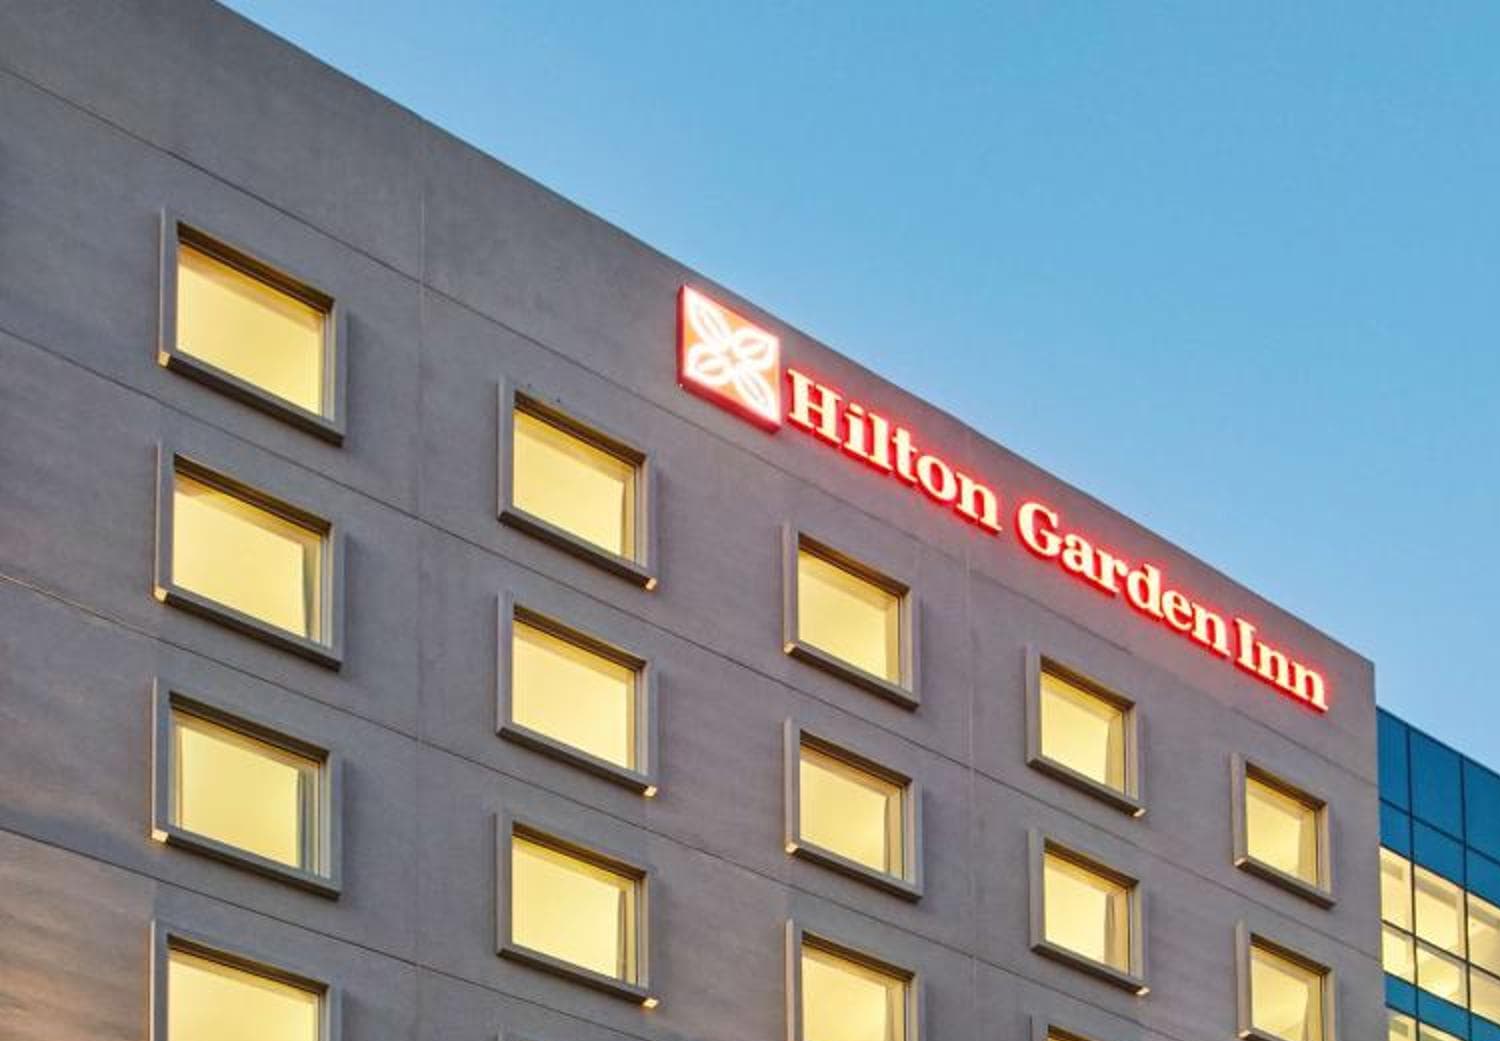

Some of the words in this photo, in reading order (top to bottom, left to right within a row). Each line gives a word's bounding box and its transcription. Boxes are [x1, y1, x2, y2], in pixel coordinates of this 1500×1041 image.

[786, 367, 1002, 533] Hilton
[1016, 499, 1231, 658] Garden
[1232, 616, 1329, 712] Inn
